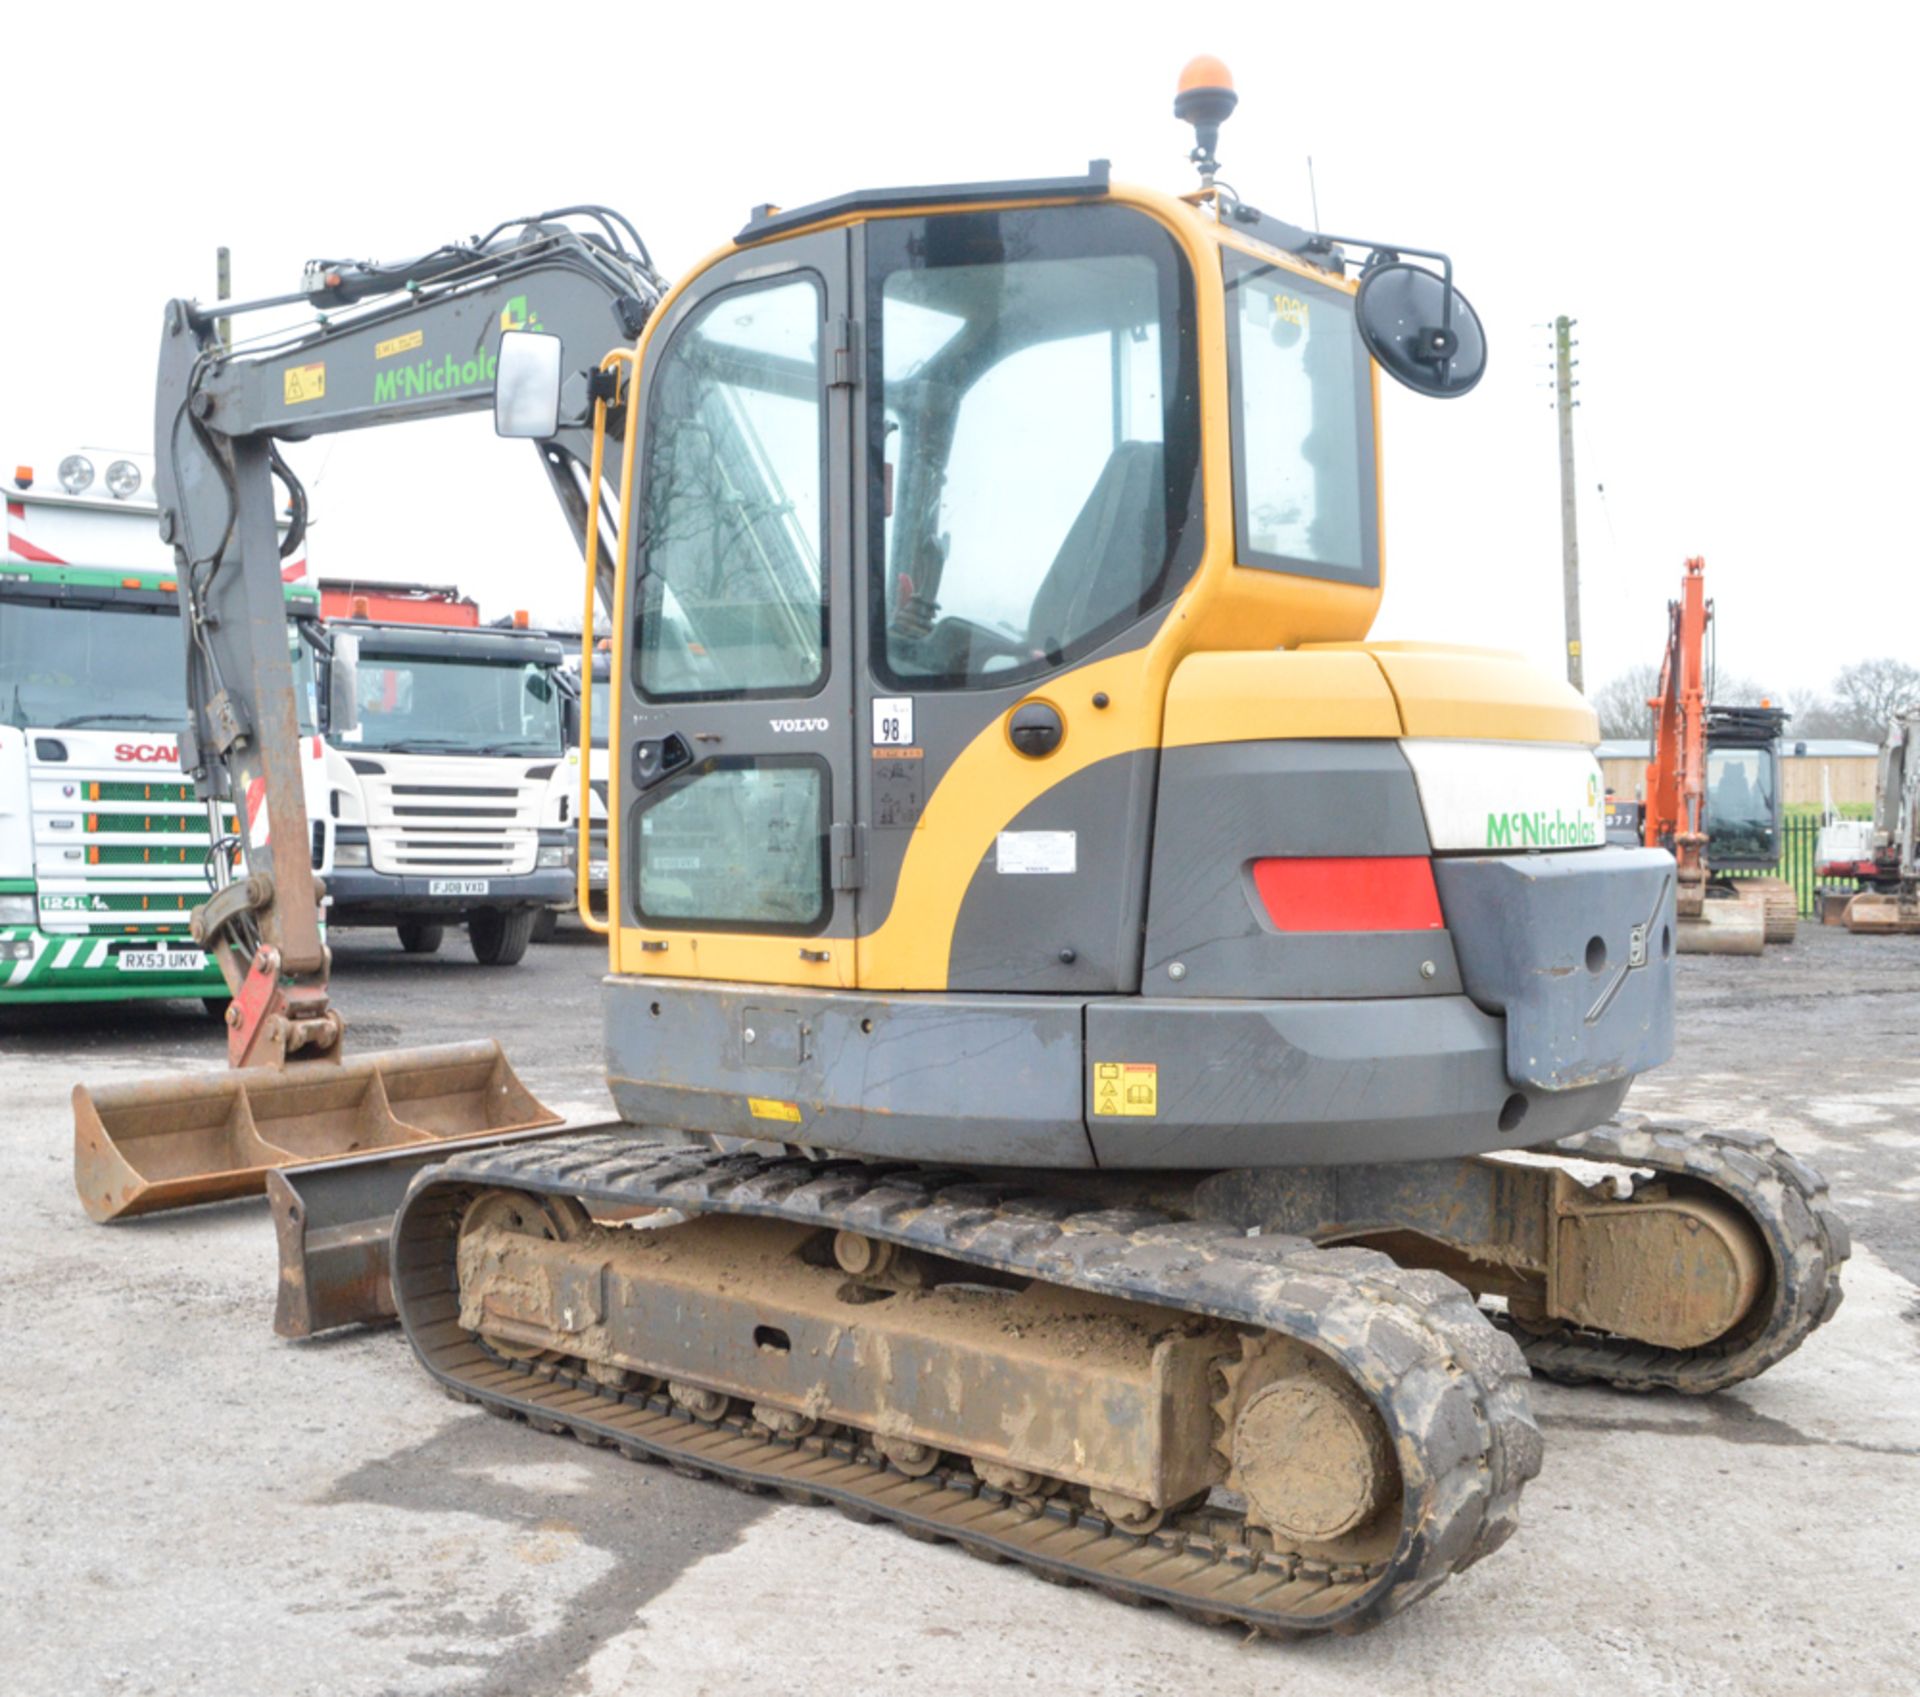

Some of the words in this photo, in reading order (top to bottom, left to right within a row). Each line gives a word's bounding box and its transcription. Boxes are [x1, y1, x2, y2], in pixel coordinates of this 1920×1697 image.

[769, 717, 829, 733] VOLVO
[882, 717, 899, 741] 98
[1487, 808, 1596, 847] McNicholas
[125, 953, 166, 968] RX53
[168, 953, 198, 967] UKV
